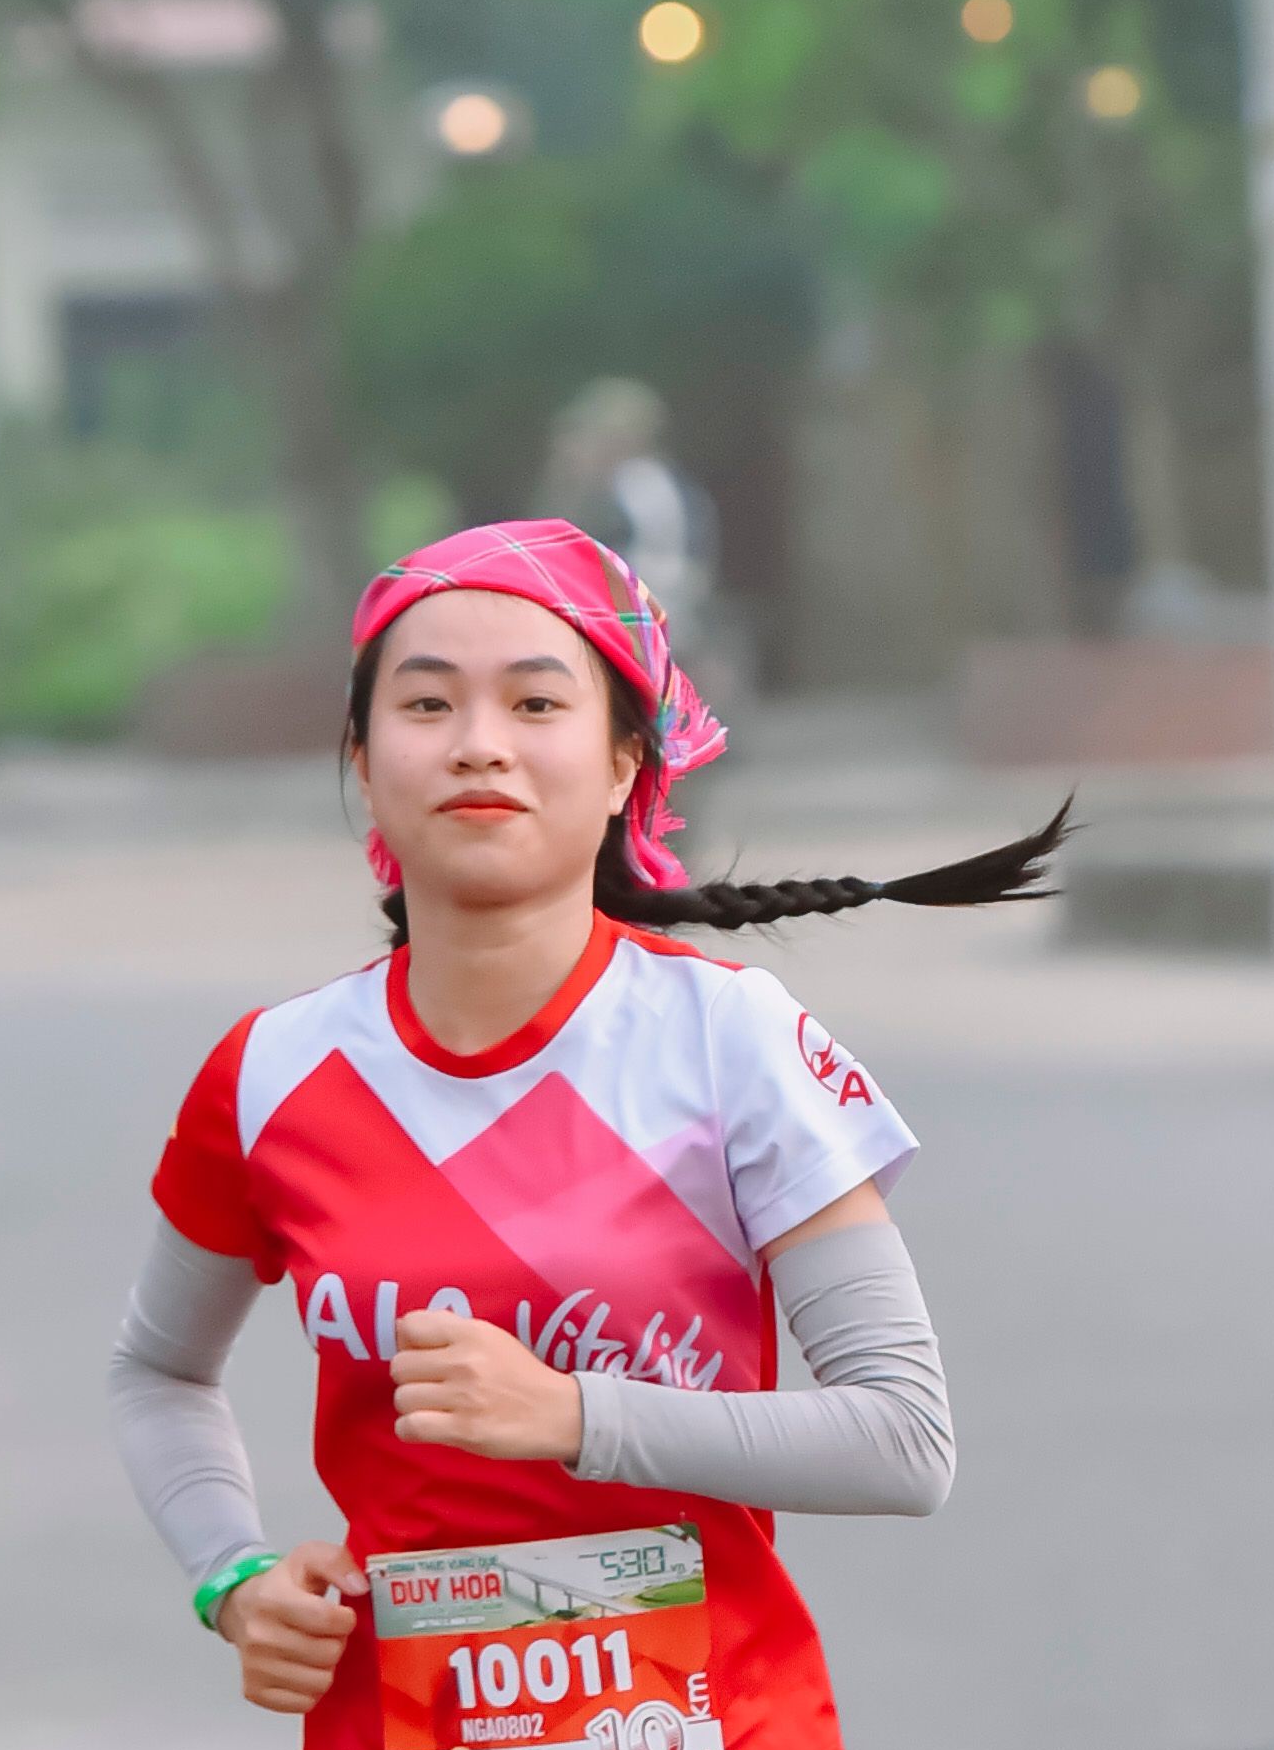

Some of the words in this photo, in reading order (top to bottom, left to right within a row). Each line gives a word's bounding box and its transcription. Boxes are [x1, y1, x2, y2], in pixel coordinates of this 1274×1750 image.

[390, 1577, 440, 1605] DUY
[448, 1629, 633, 1709] 10011
[685, 1672, 712, 1720] km
